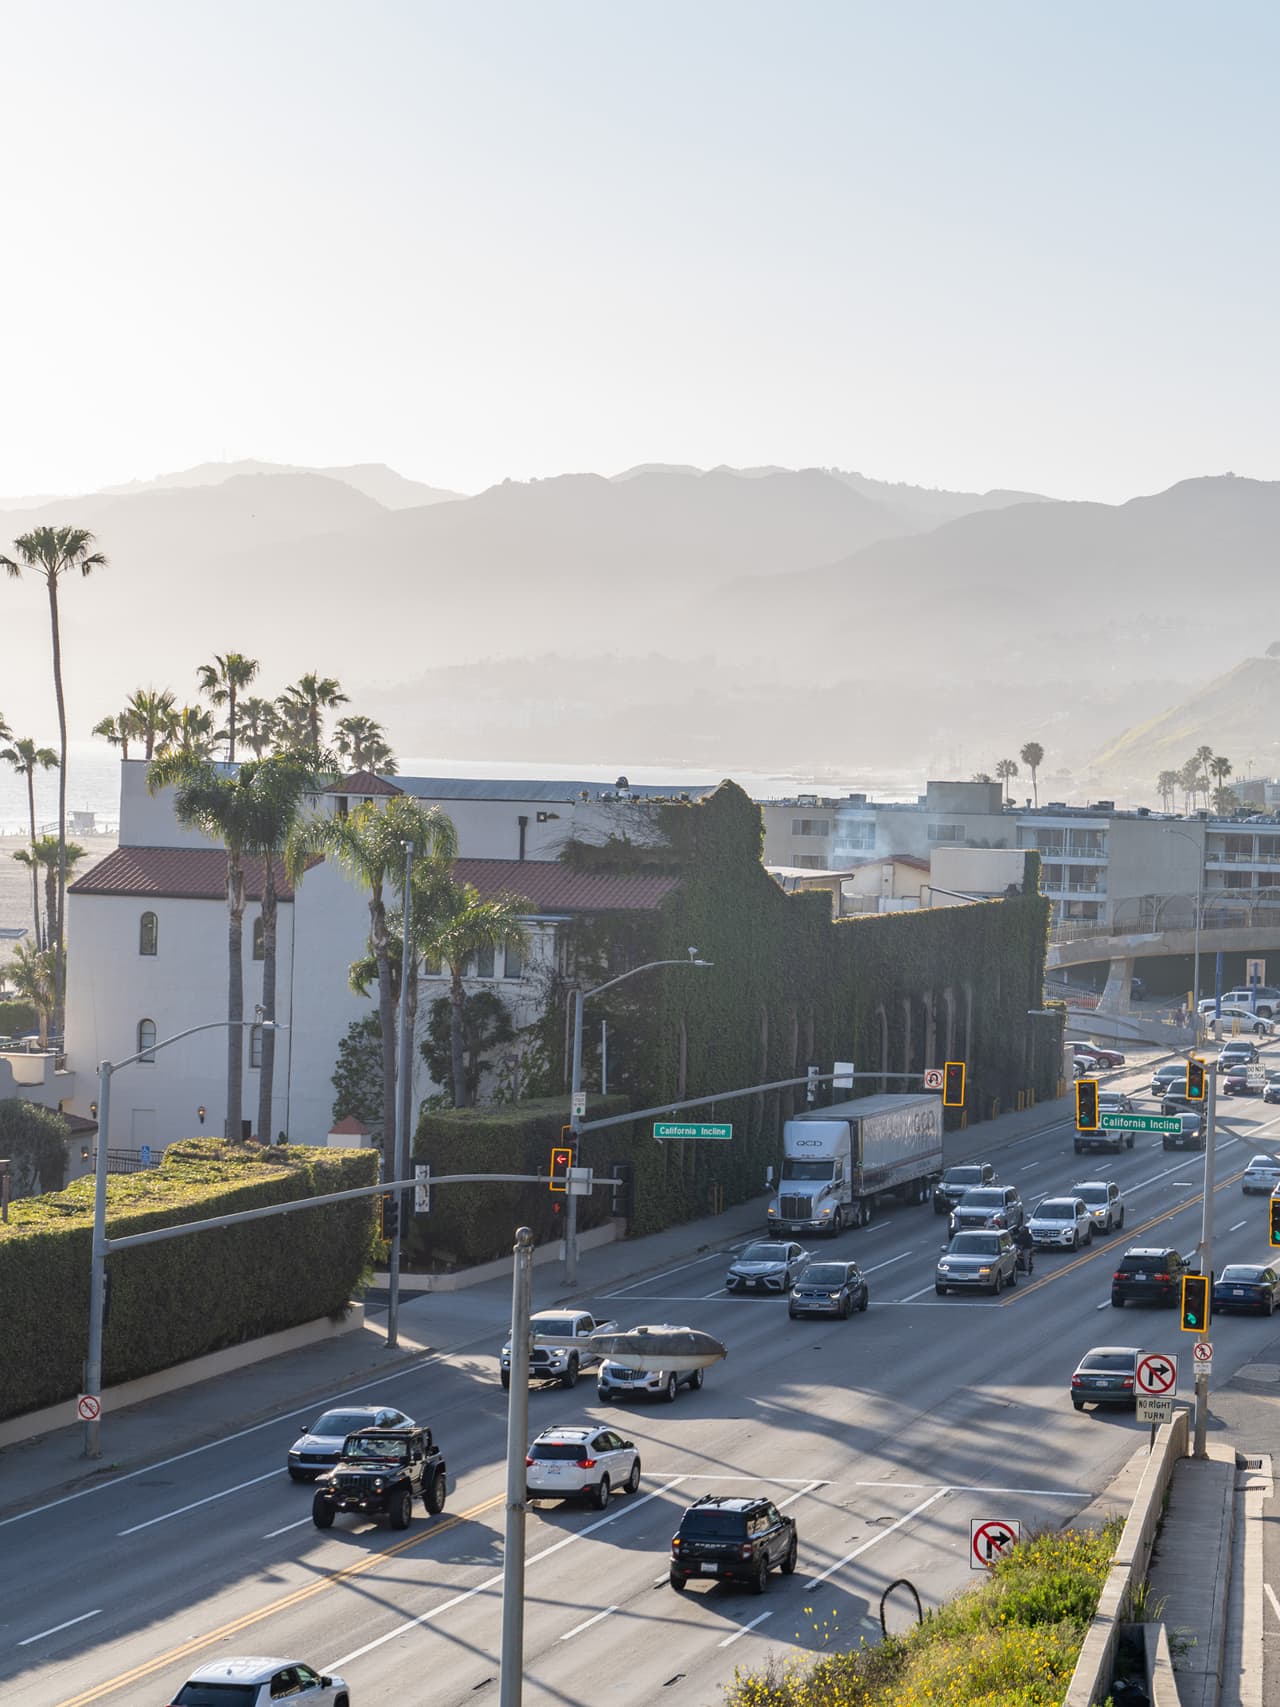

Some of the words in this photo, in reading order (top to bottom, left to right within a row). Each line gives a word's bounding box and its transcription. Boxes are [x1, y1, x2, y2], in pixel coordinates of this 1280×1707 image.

[1102, 1117, 1146, 1129] California
[1150, 1119, 1180, 1130] Incline
[659, 1126, 697, 1135] California
[701, 1127, 726, 1136] Incline
[1138, 1400, 1147, 1409] NO
[1148, 1400, 1171, 1409] RIGHT
[1144, 1411, 1165, 1420] TURN
